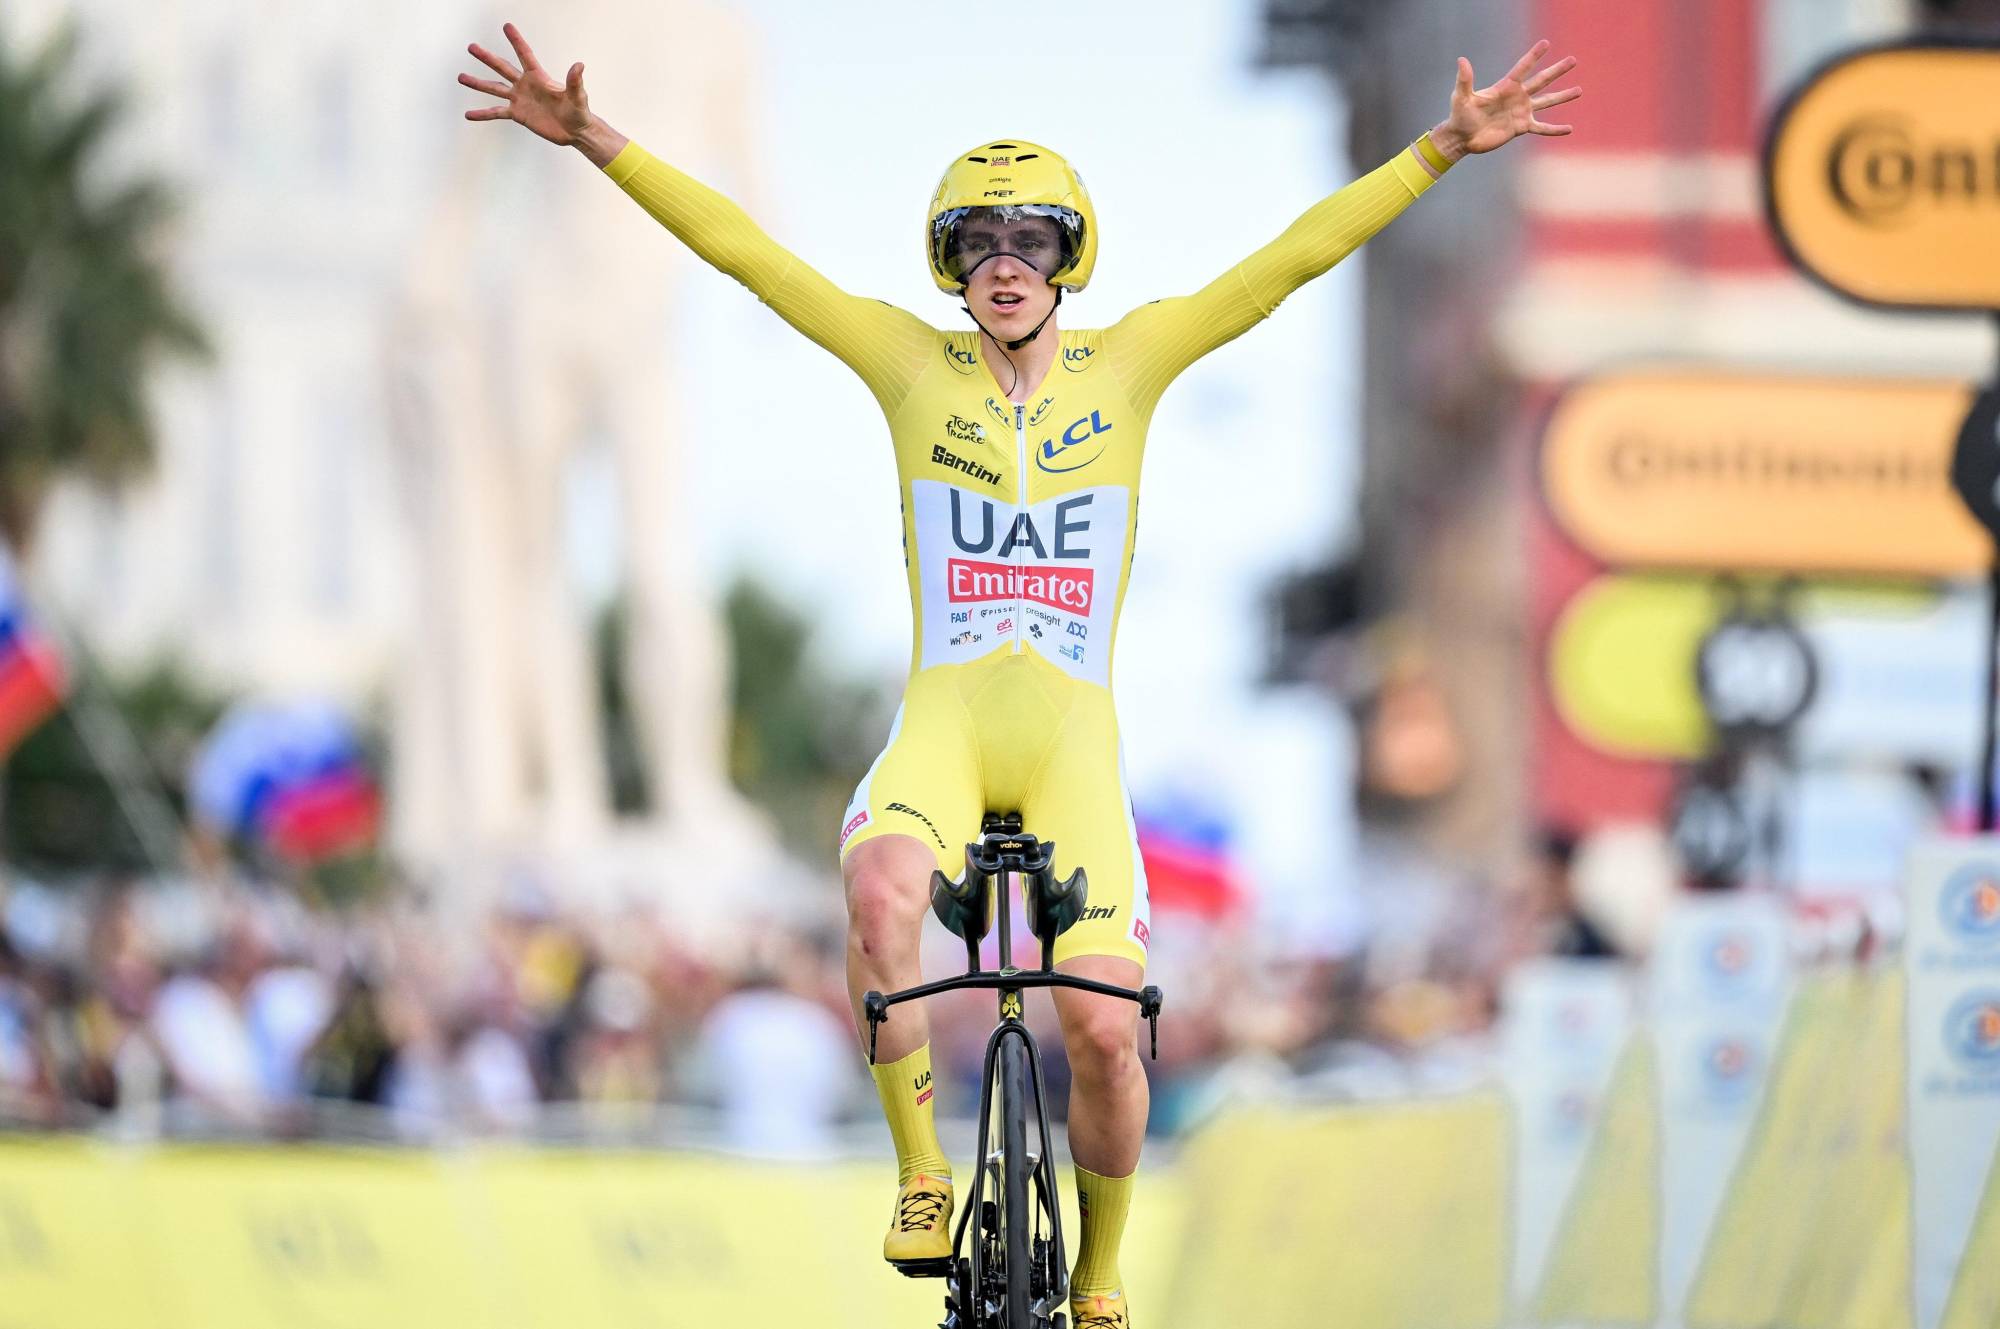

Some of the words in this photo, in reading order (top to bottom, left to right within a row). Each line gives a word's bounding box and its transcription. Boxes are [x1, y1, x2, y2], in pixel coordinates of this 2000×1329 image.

[983, 190, 1016, 198] MET
[1065, 346, 1096, 361] LCL
[1042, 409, 1113, 460] LCL
[931, 443, 1003, 486] Santini
[949, 487, 1095, 560] UAE
[951, 563, 1090, 609] Emirates
[1025, 607, 1061, 626] presight
[884, 802, 946, 849] Santini
[1078, 905, 1118, 922] tini
[914, 1070, 932, 1090] UA
